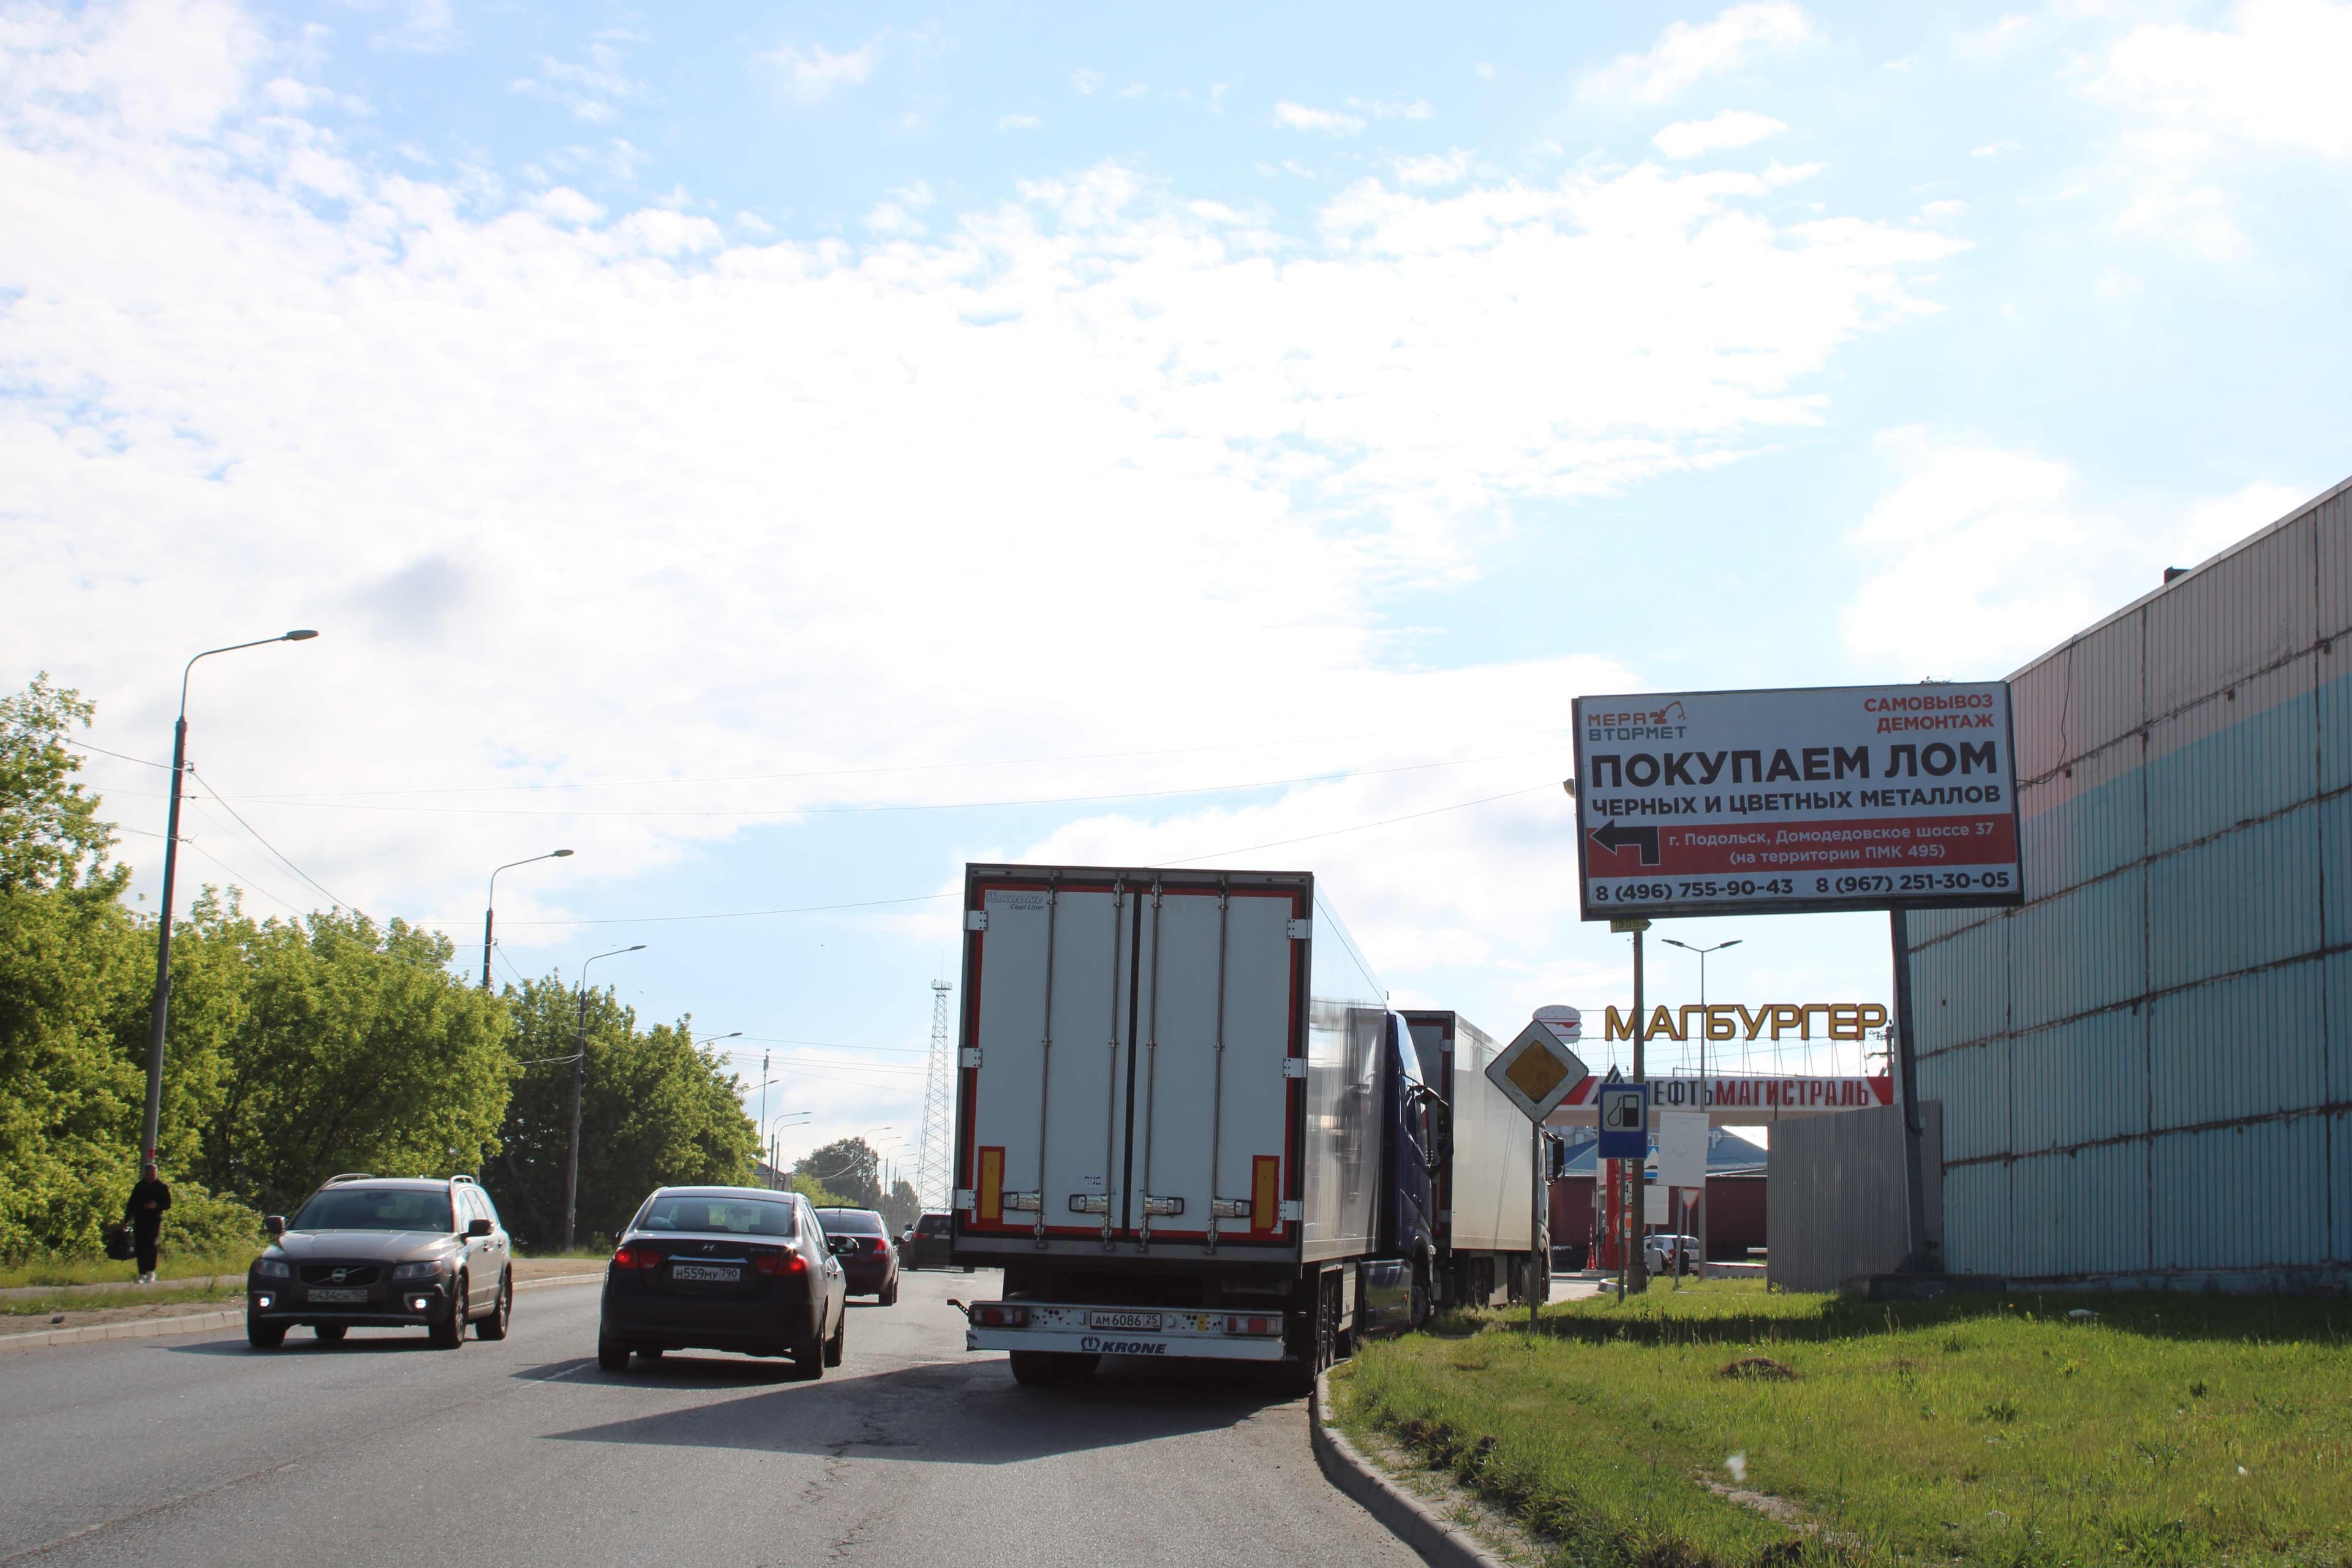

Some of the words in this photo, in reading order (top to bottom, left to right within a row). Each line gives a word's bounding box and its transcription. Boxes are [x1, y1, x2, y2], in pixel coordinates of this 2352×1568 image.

[1864, 693, 1994, 712] САМОВЫВОЗ
[1588, 712, 1646, 726] МЕРА
[1877, 714, 1995, 734] ДЕМОНТАЖ
[1588, 726, 1687, 742] ВТОРМЕТ
[1591, 745, 1870, 788] ПОКУПАЕМ
[1884, 741, 1997, 778] ЛОМ
[1592, 797, 1698, 816] ЧЕРНЫХ
[1705, 796, 1722, 813] И
[1729, 791, 1853, 815] ЦВЕТНЫХ
[1860, 785, 2001, 807] МЕТАЛЛОВ
[1669, 836, 1679, 846] г.
[1685, 832, 1771, 847] Подольск,
[1776, 827, 1911, 845] Домодедовское
[1917, 825, 1970, 838] шоссе
[1975, 822, 1994, 835] 37
[1730, 852, 1756, 865] (на
[1760, 848, 1860, 864] территории
[1865, 845, 1902, 859] ПМК
[1908, 843, 1946, 858] 495)
[1596, 885, 1609, 902] 8
[1615, 883, 1673, 903] (496)
[1679, 878, 1794, 898] 755-90-43
[1815, 877, 1829, 893] 8
[1836, 875, 1893, 894] (967)
[1900, 872, 2010, 890] 251-30-05
[1605, 1003, 1888, 1041] МАГБУРГЕР
[1146, 1315, 1157, 1324] 25
[1101, 1341, 1167, 1354] KRONE
